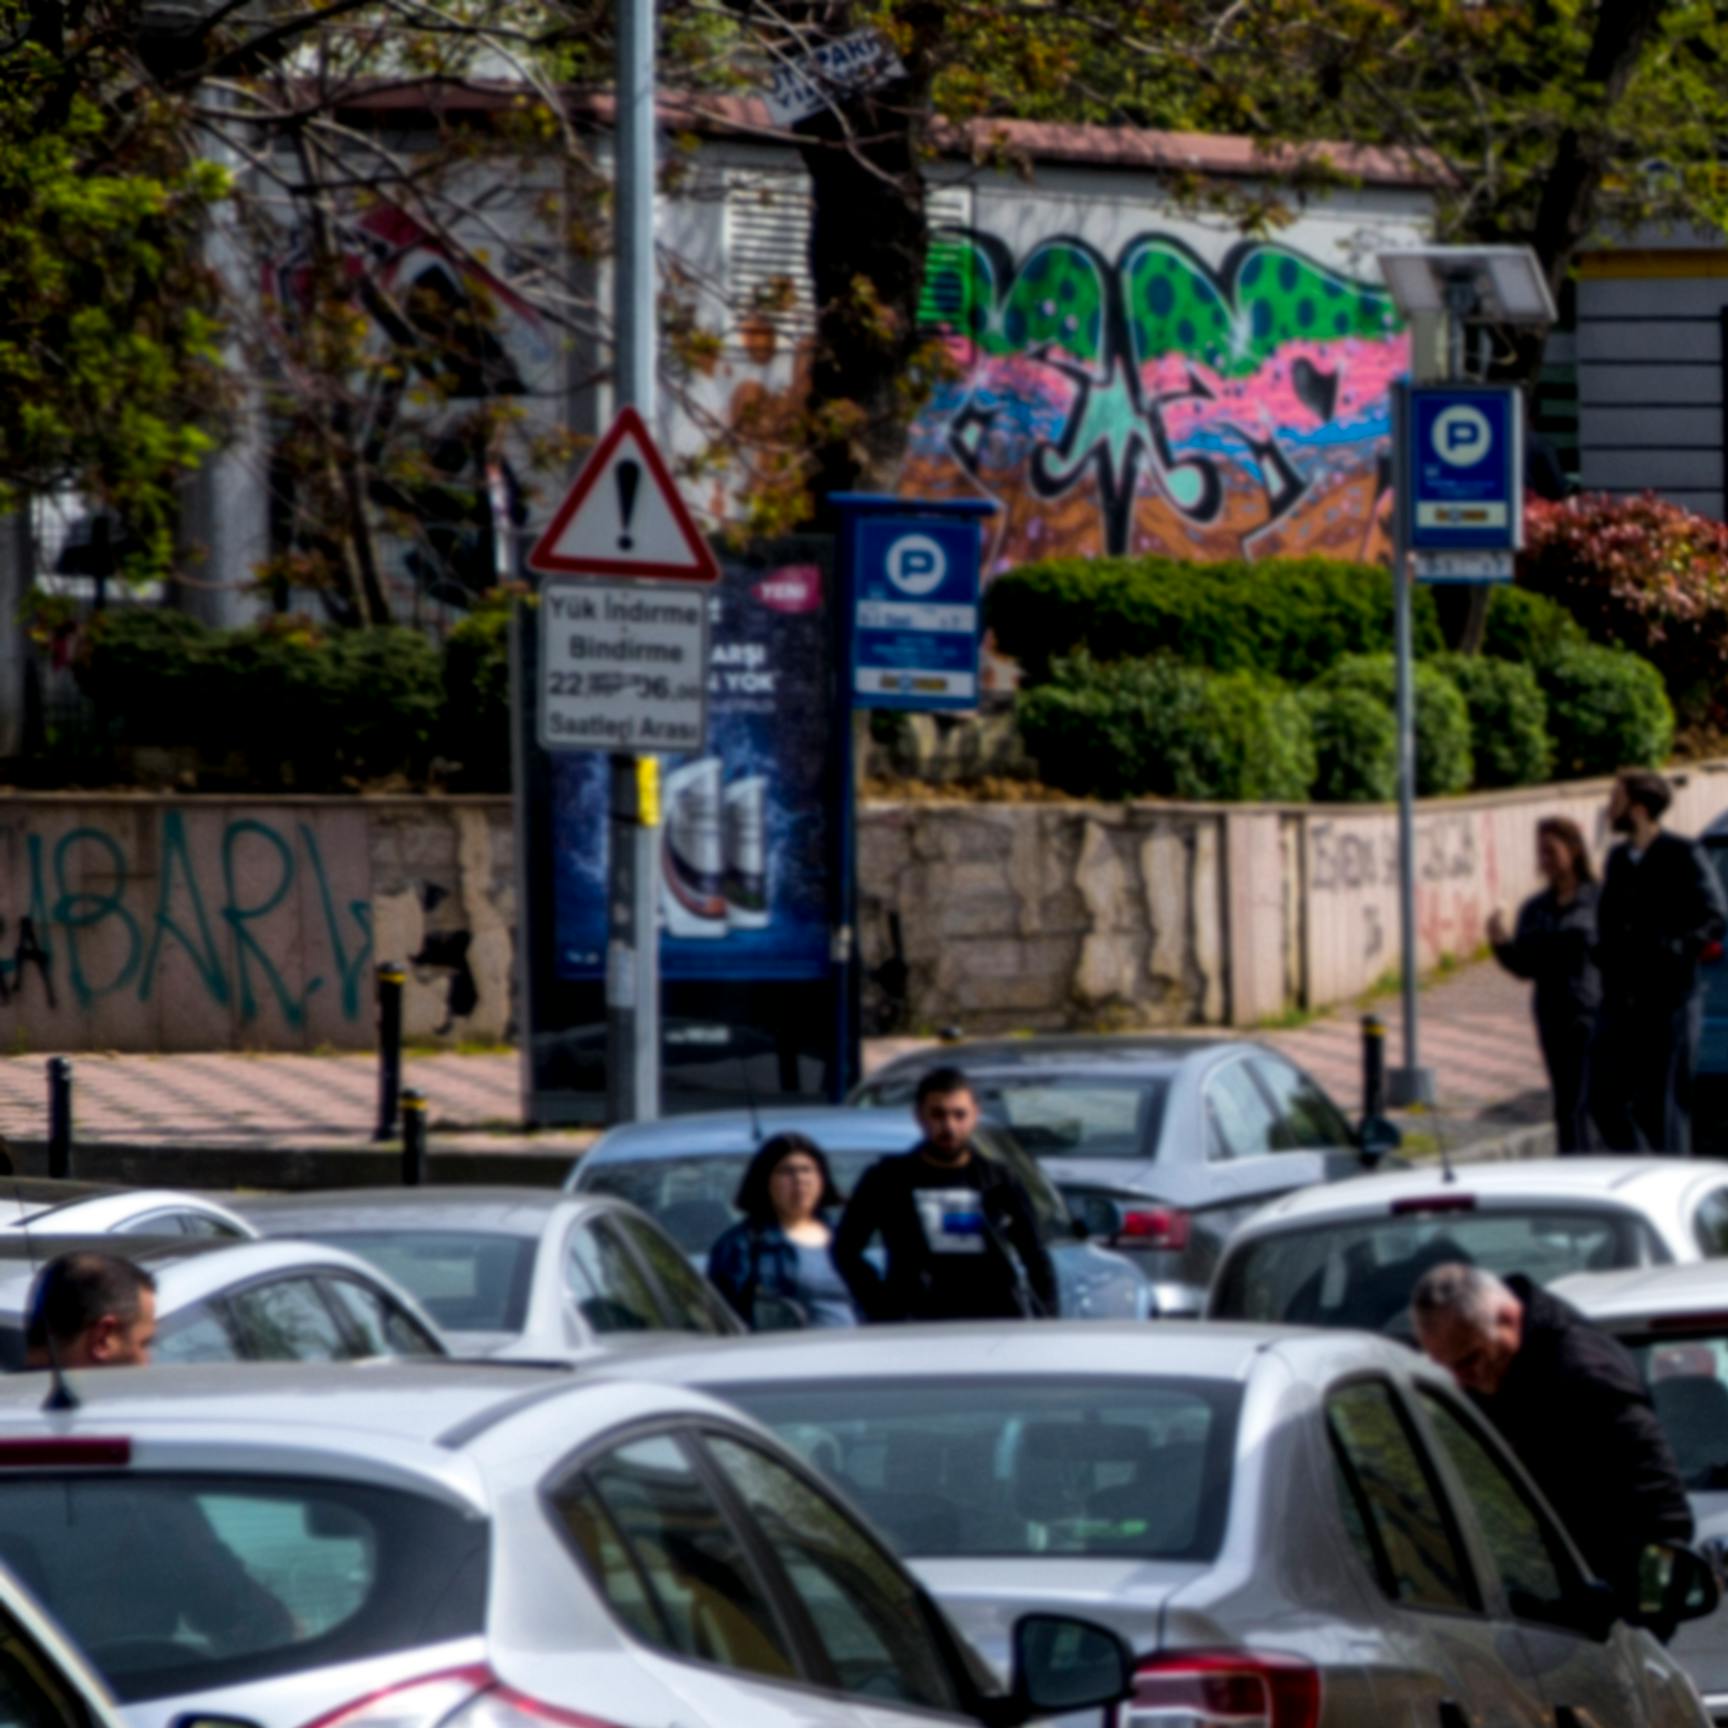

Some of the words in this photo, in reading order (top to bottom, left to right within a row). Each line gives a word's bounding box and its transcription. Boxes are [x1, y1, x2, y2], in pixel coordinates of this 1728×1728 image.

[550, 596, 596, 619] Yük
[569, 635, 683, 664] Bindirme
[711, 645, 766, 671] ARŞI
